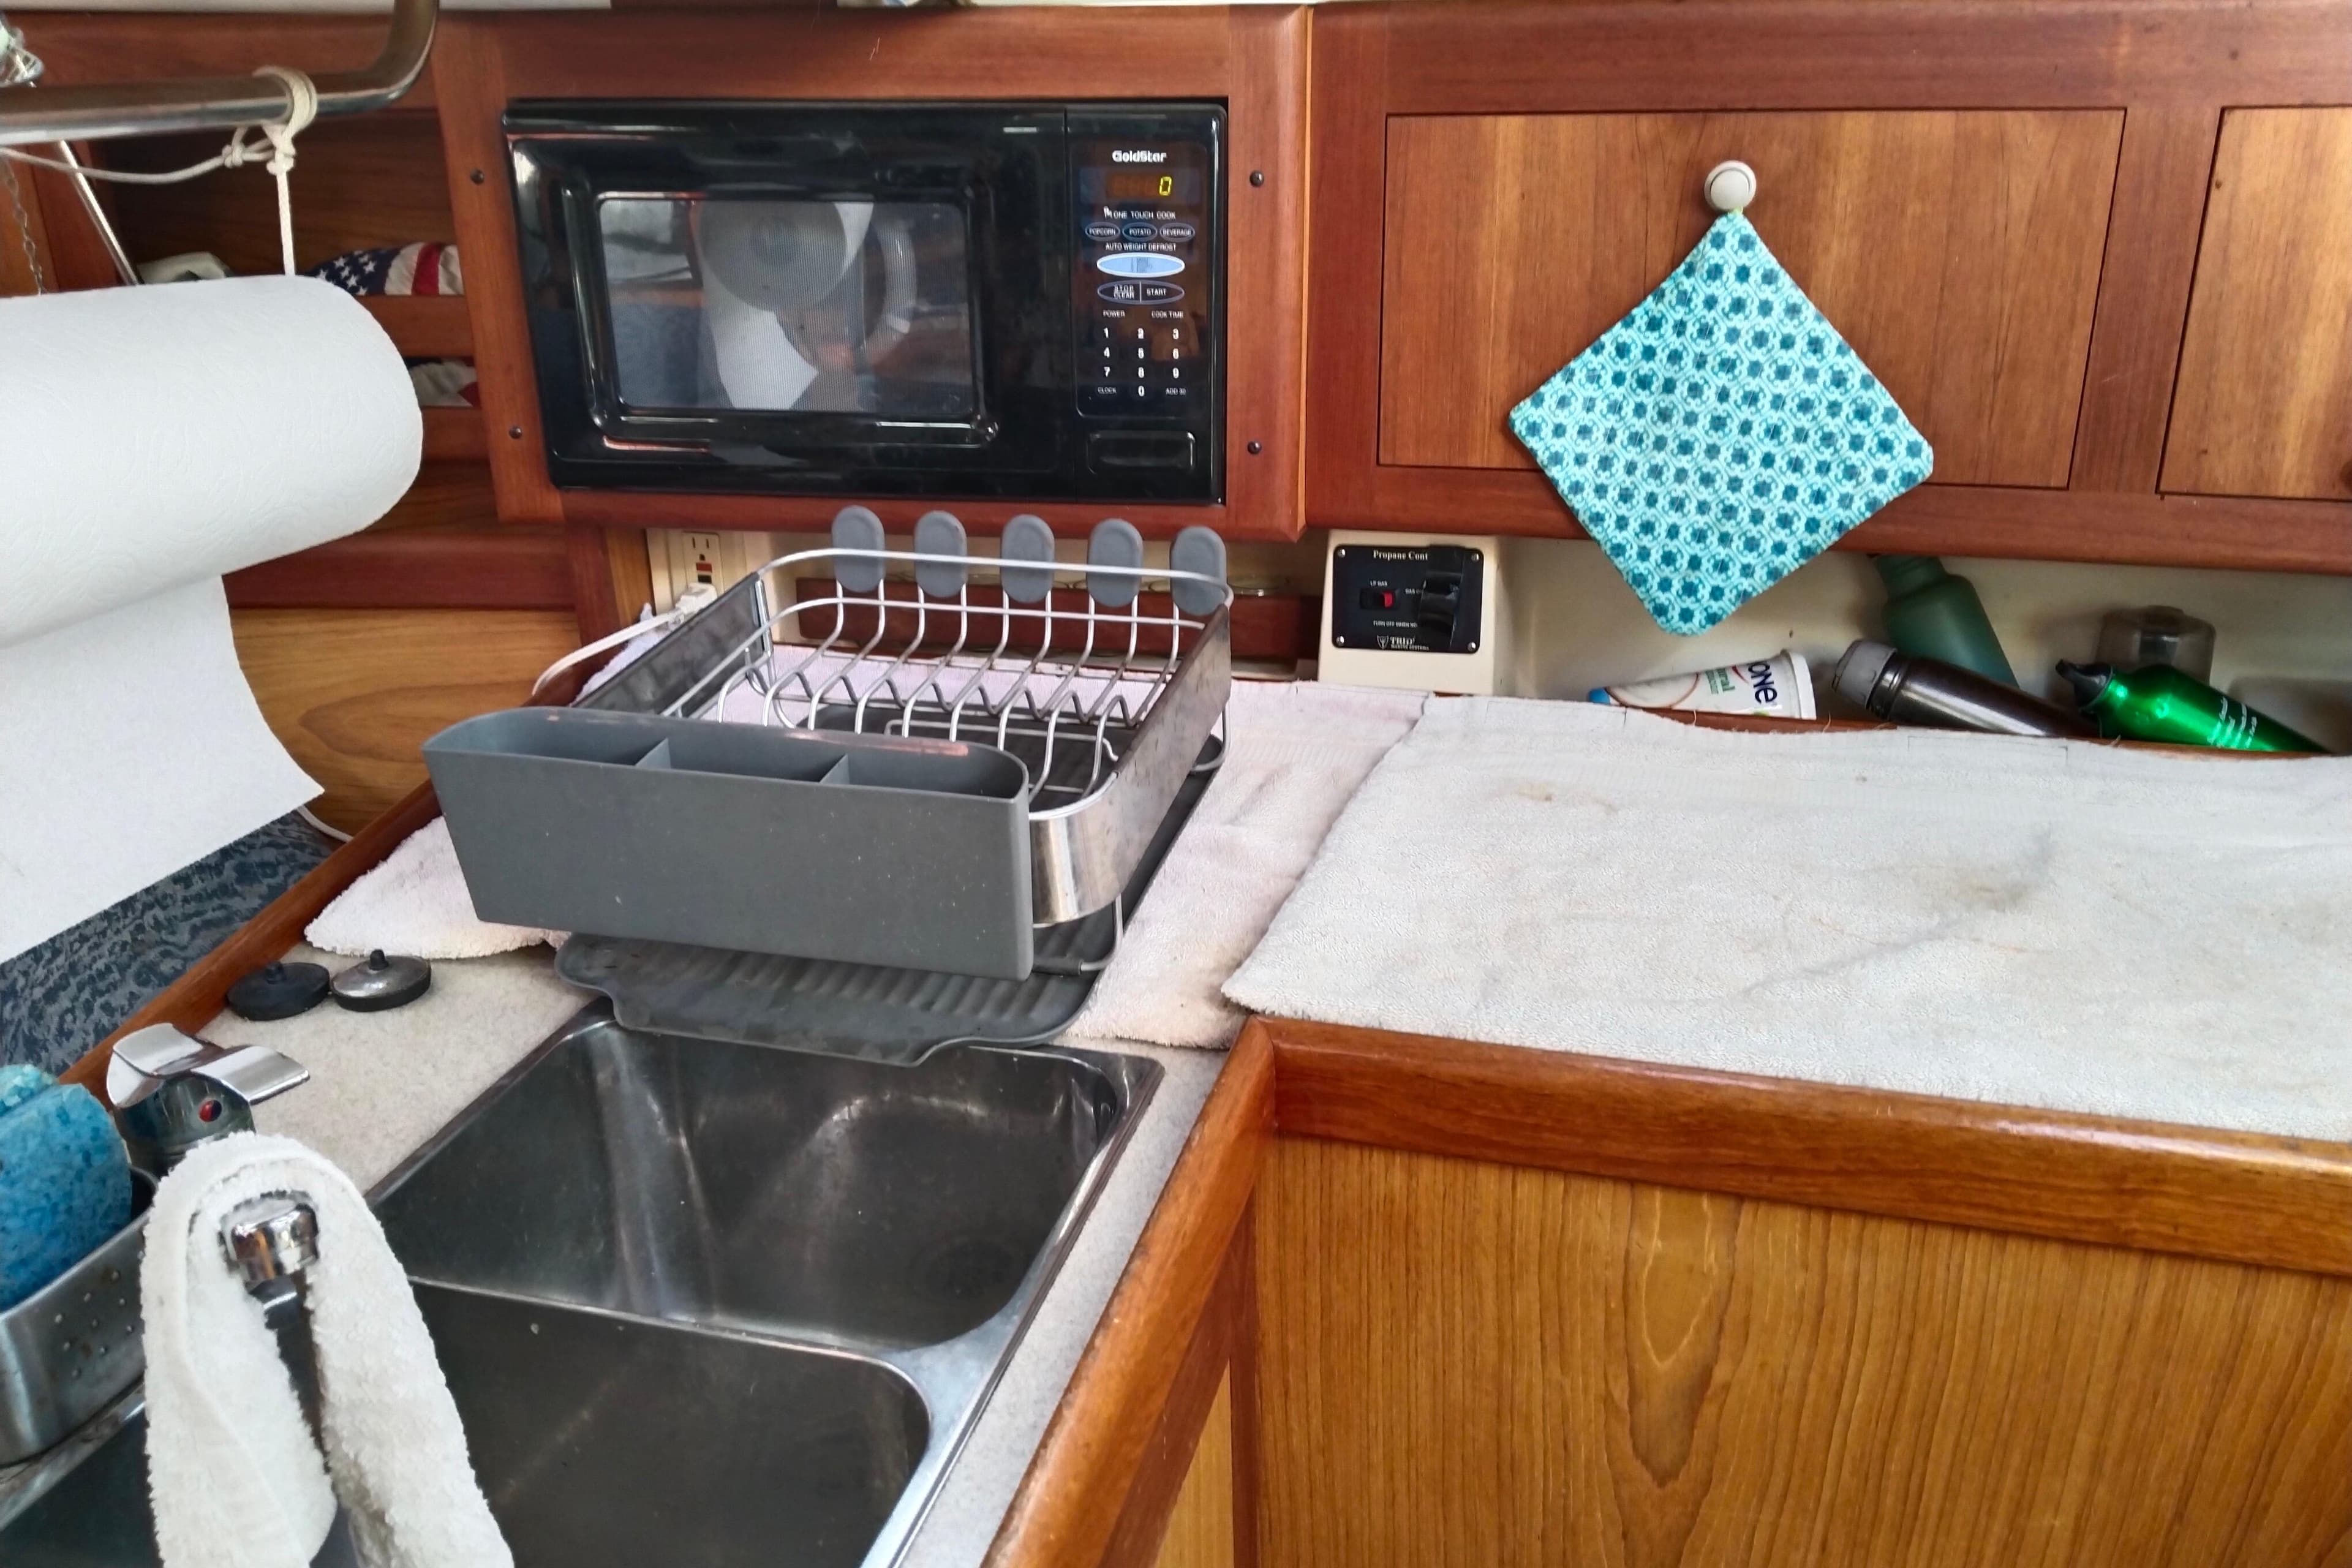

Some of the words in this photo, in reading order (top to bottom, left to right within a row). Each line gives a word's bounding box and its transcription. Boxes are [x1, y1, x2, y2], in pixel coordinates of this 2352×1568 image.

[1112, 150, 1167, 162] GoldStar
[1159, 176, 1172, 195] 0
[1113, 210, 1128, 219] ONE
[1131, 210, 1154, 219] TOUCH
[1156, 211, 1176, 219] COOK
[1123, 243, 1147, 251] WEIGHT
[1148, 243, 1176, 251] DEFROST
[1114, 290, 1134, 299] CLEAR
[1104, 328, 1109, 338] 1
[1137, 328, 1144, 339] 2
[1173, 328, 1179, 339] 3
[1104, 347, 1110, 358] 4
[1138, 348, 1144, 359] 5
[1173, 348, 1179, 360] 6
[1104, 366, 1110, 377] 7
[1138, 367, 1144, 379] 8
[1173, 368, 1179, 379] 9
[1138, 385, 1145, 396] 0
[1373, 550, 1406, 561] Propane
